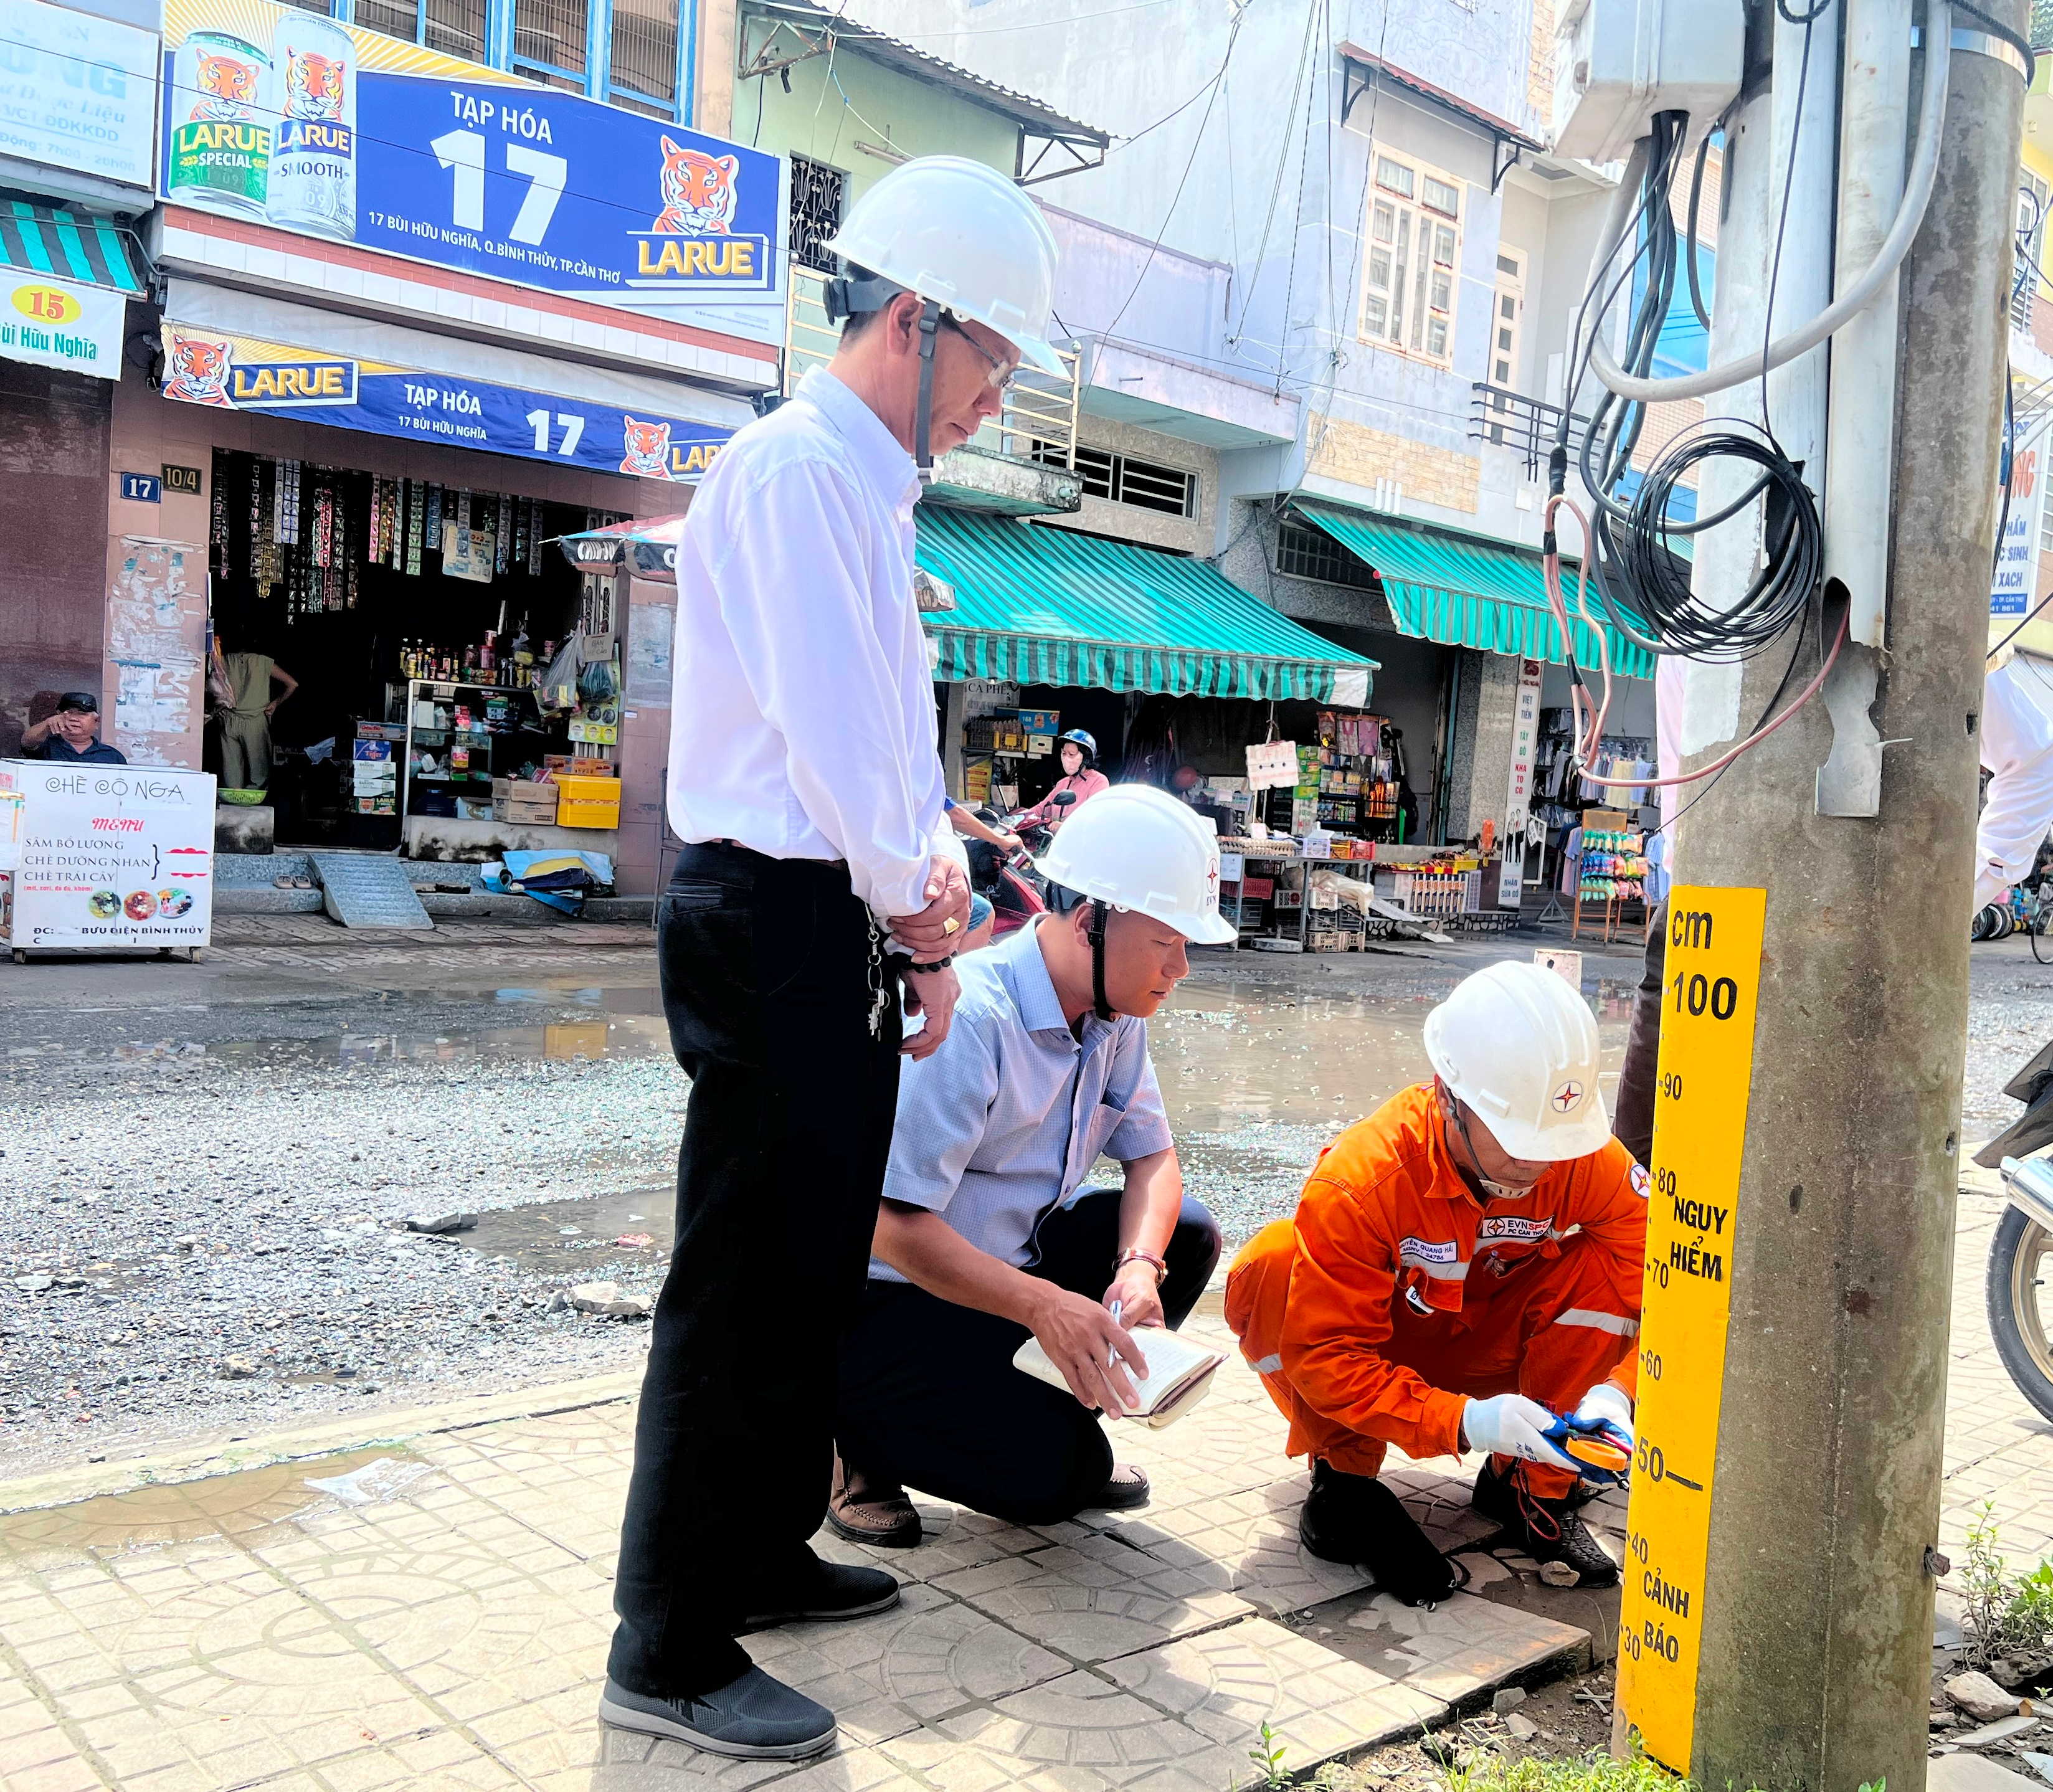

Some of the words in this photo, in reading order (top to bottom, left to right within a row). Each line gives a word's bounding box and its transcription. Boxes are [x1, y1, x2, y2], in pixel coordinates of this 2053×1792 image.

[79, 98, 126, 123] Liệu
[450, 90, 495, 128] TẠP
[501, 107, 553, 145] HÓA
[179, 124, 270, 153] LARUE
[278, 125, 349, 151] LARUE
[199, 153, 253, 168] SPECIAL
[282, 161, 343, 179] SMOOTH
[429, 128, 567, 247] 17
[369, 211, 384, 226] 17
[387, 215, 409, 232] BÙI
[412, 221, 439, 240] HỮU
[441, 229, 482, 253] NGHĨA,
[485, 240, 525, 262] Q.BÌNH
[528, 250, 559, 271] THỦY,
[560, 258, 596, 279] TP.CẦN
[598, 267, 620, 283] THƠ
[638, 240, 754, 277] LARUE
[29, 291, 65, 320] 15
[0, 322, 16, 345] ùi
[21, 326, 49, 351] Hữu
[54, 332, 97, 361] Nghĩa
[234, 366, 344, 399] LARUE
[404, 384, 438, 410] TẠP
[442, 390, 482, 416] HÓA
[398, 415, 410, 427] 17
[413, 417, 430, 431] BÙI
[432, 420, 453, 435] HỮU
[456, 426, 487, 440] NGHĨA
[526, 409, 585, 456] 17
[672, 445, 721, 472] LAR
[129, 478, 151, 498] 17
[166, 468, 197, 490] 10/4
[2006, 514, 2027, 536] HẨM
[2008, 546, 2029, 561] SINH
[1515, 764, 1527, 772] KHA
[1517, 775, 1524, 783] TO
[45, 775, 87, 795] CHÈ
[95, 778, 128, 796] CÔ
[135, 780, 184, 800] NGA
[92, 817, 145, 833] MENU
[26, 837, 52, 848] SÂM
[57, 835, 74, 848] BỔ
[77, 839, 124, 851] LƯỢNG
[25, 855, 53, 865] CHÈ
[57, 855, 108, 866] DƯỠNG
[111, 857, 150, 867] NHAN
[24, 870, 52, 881] CHÈ
[55, 870, 86, 881] TRÁI
[90, 871, 116, 882] CÂY
[110, 926, 138, 936] ĐIỆN
[141, 926, 171, 934] BÌNH
[173, 925, 204, 934] THỦY
[1672, 910, 1713, 949] cm
[1673, 971, 1738, 1020] 100
[1663, 1072, 1682, 1101] 90
[1658, 1167, 1676, 1197] 80
[1674, 1198, 1728, 1235] NGUY
[1420, 1244, 1443, 1254] QUANG
[1671, 1236, 1722, 1282] HIỂM
[1653, 1257, 1669, 1289] 70
[1646, 1349, 1662, 1382] 60
[1638, 1436, 1664, 1482] 50
[1631, 1530, 1648, 1565] 40
[1643, 1567, 1690, 1618] CẢNH
[1624, 1625, 1641, 1662] 30
[1644, 1619, 1679, 1664] BÁO
